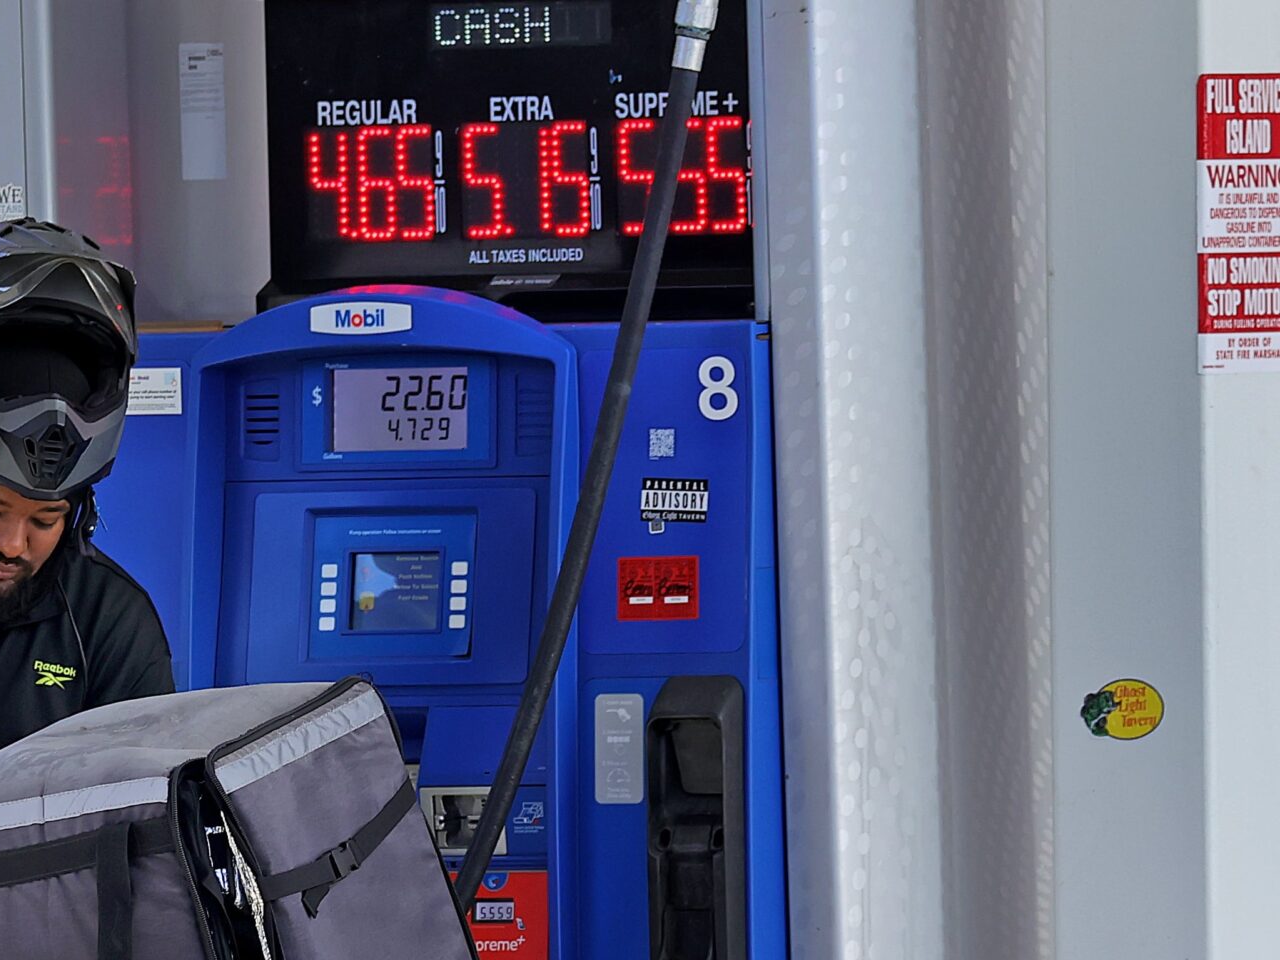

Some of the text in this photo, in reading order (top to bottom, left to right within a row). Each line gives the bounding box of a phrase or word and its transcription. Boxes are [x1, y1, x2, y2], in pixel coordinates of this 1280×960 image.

[433, 5, 551, 46] CASH
[489, 96, 554, 122] EXTRA
[1206, 79, 1235, 114] FULL
[317, 99, 417, 125] REGULAR
[1226, 119, 1271, 154] ISLAND
[1207, 165, 1280, 188] WARNIN
[469, 248, 583, 264] ALL TAXES INCLUDED
[1207, 258, 1227, 285] NO
[1207, 289, 1242, 317] STOP
[334, 309, 385, 328] Mobil
[312, 386, 322, 406] $
[698, 355, 738, 420] 8
[646, 480, 705, 490] PARENTAL
[644, 492, 705, 509] ADVISORY
[34, 660, 76, 677] Reebok
